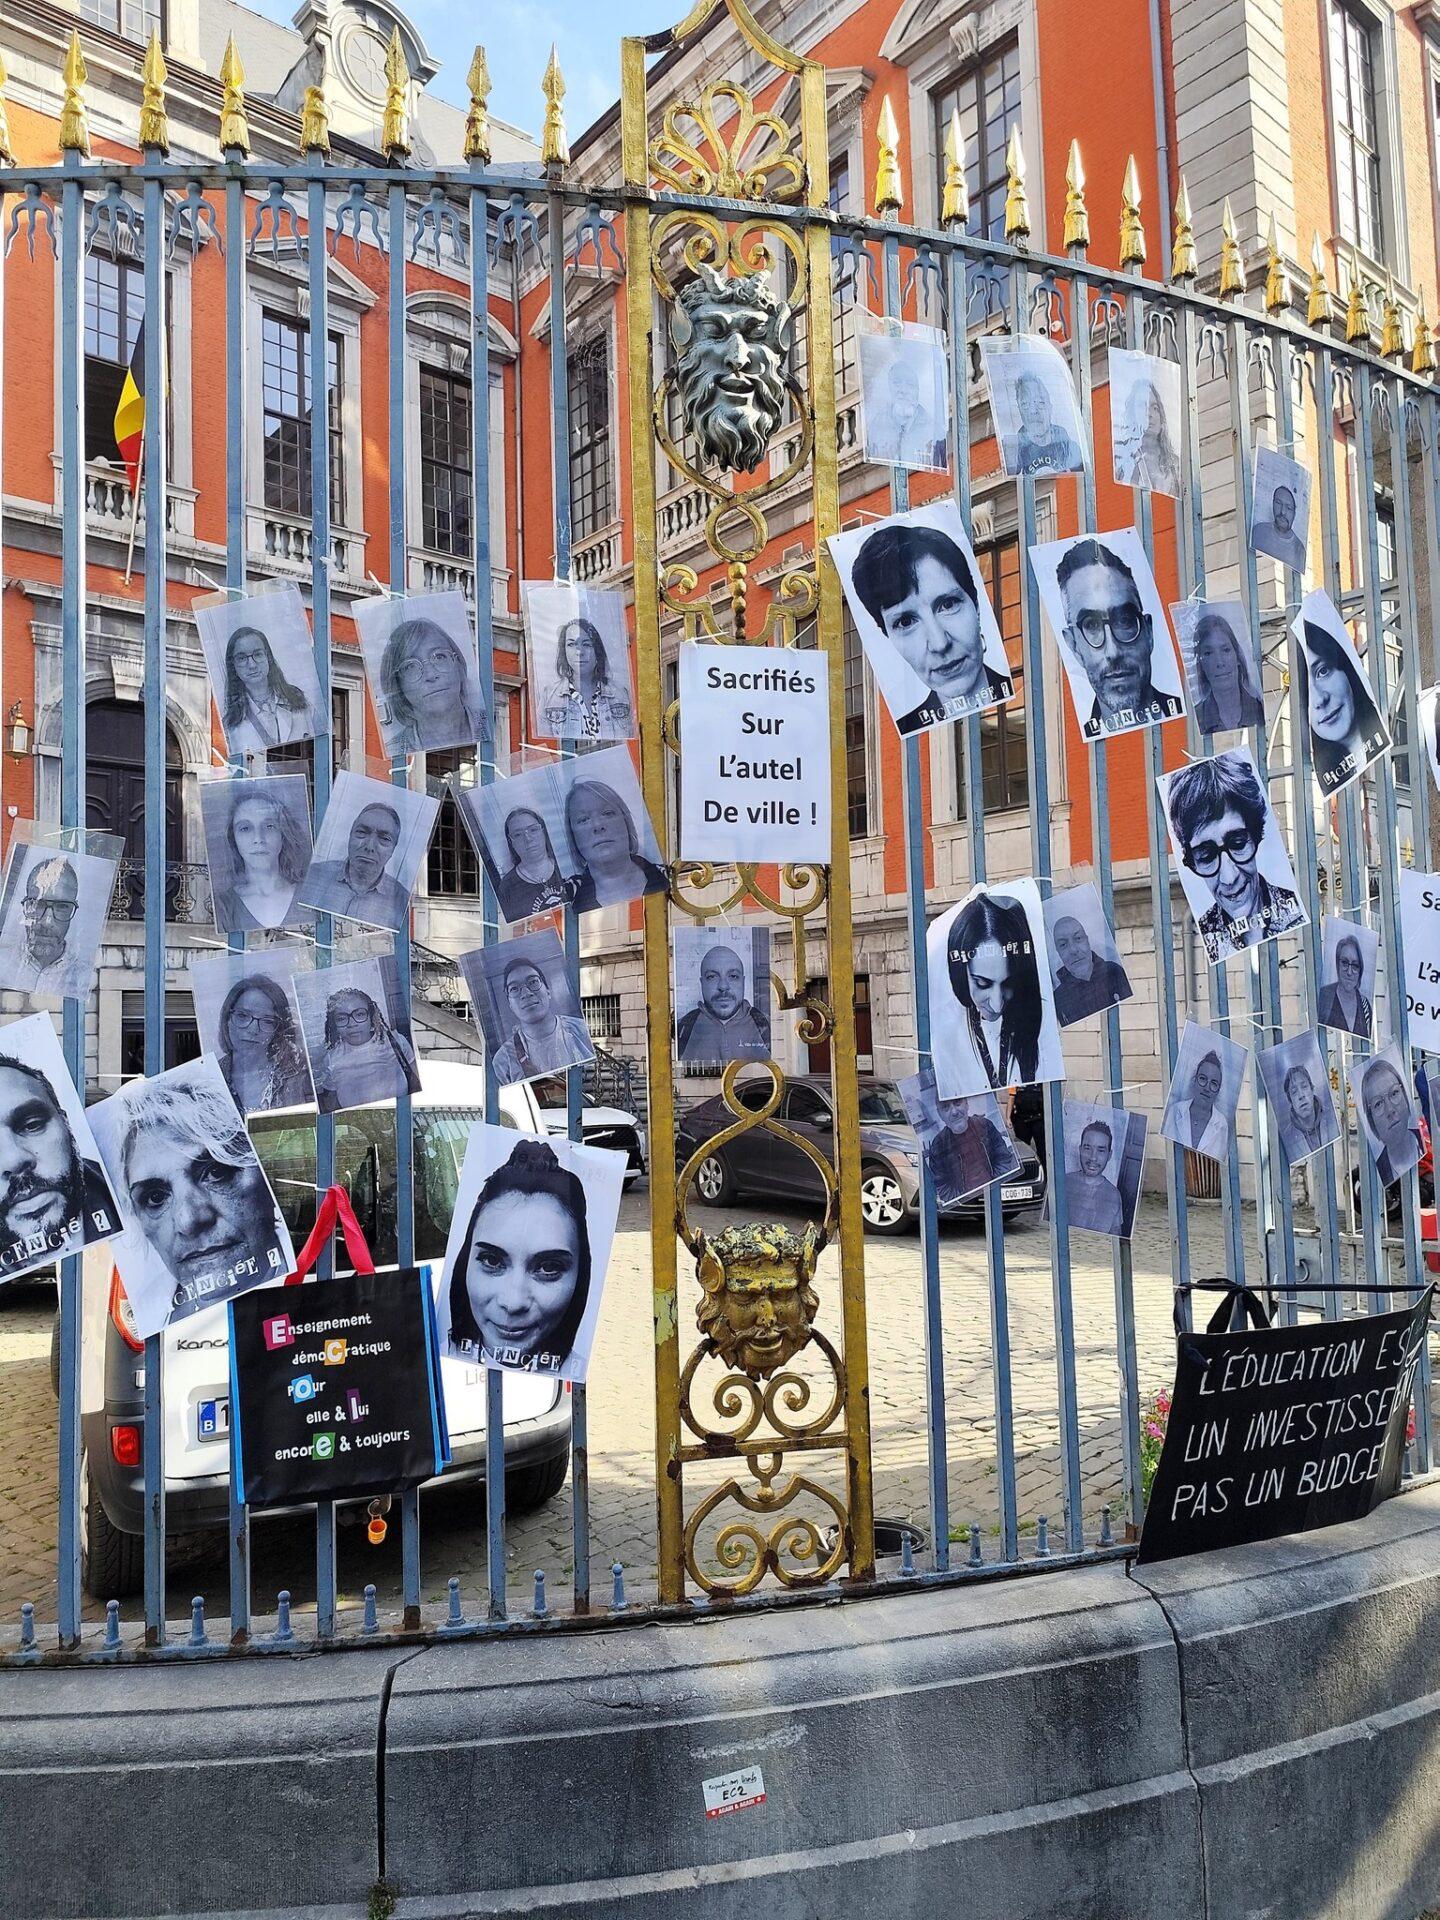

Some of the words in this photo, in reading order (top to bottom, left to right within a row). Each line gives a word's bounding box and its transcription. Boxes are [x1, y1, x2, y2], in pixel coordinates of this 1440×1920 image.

[707, 666, 816, 694] Sacrifiés
[741, 712, 784, 735] Sur
[719, 754, 802, 781] L'autel
[704, 800, 739, 823] De
[747, 801, 800, 825] ville
[811, 802, 817, 825] !
[271, 1313, 373, 1344] Enseignement
[306, 1409, 331, 1424] elle
[335, 1406, 347, 1421] &
[350, 1397, 370, 1420] lui
[204, 1420, 214, 1431] B
[275, 1435, 333, 1460] encore
[339, 1436, 351, 1452] &
[355, 1429, 411, 1449] toujours
[1184, 1418, 1230, 1462] UN
[1171, 1477, 1234, 1521] PAS
[1245, 1466, 1286, 1508] UN
[722, 1785, 748, 1801] EC2
